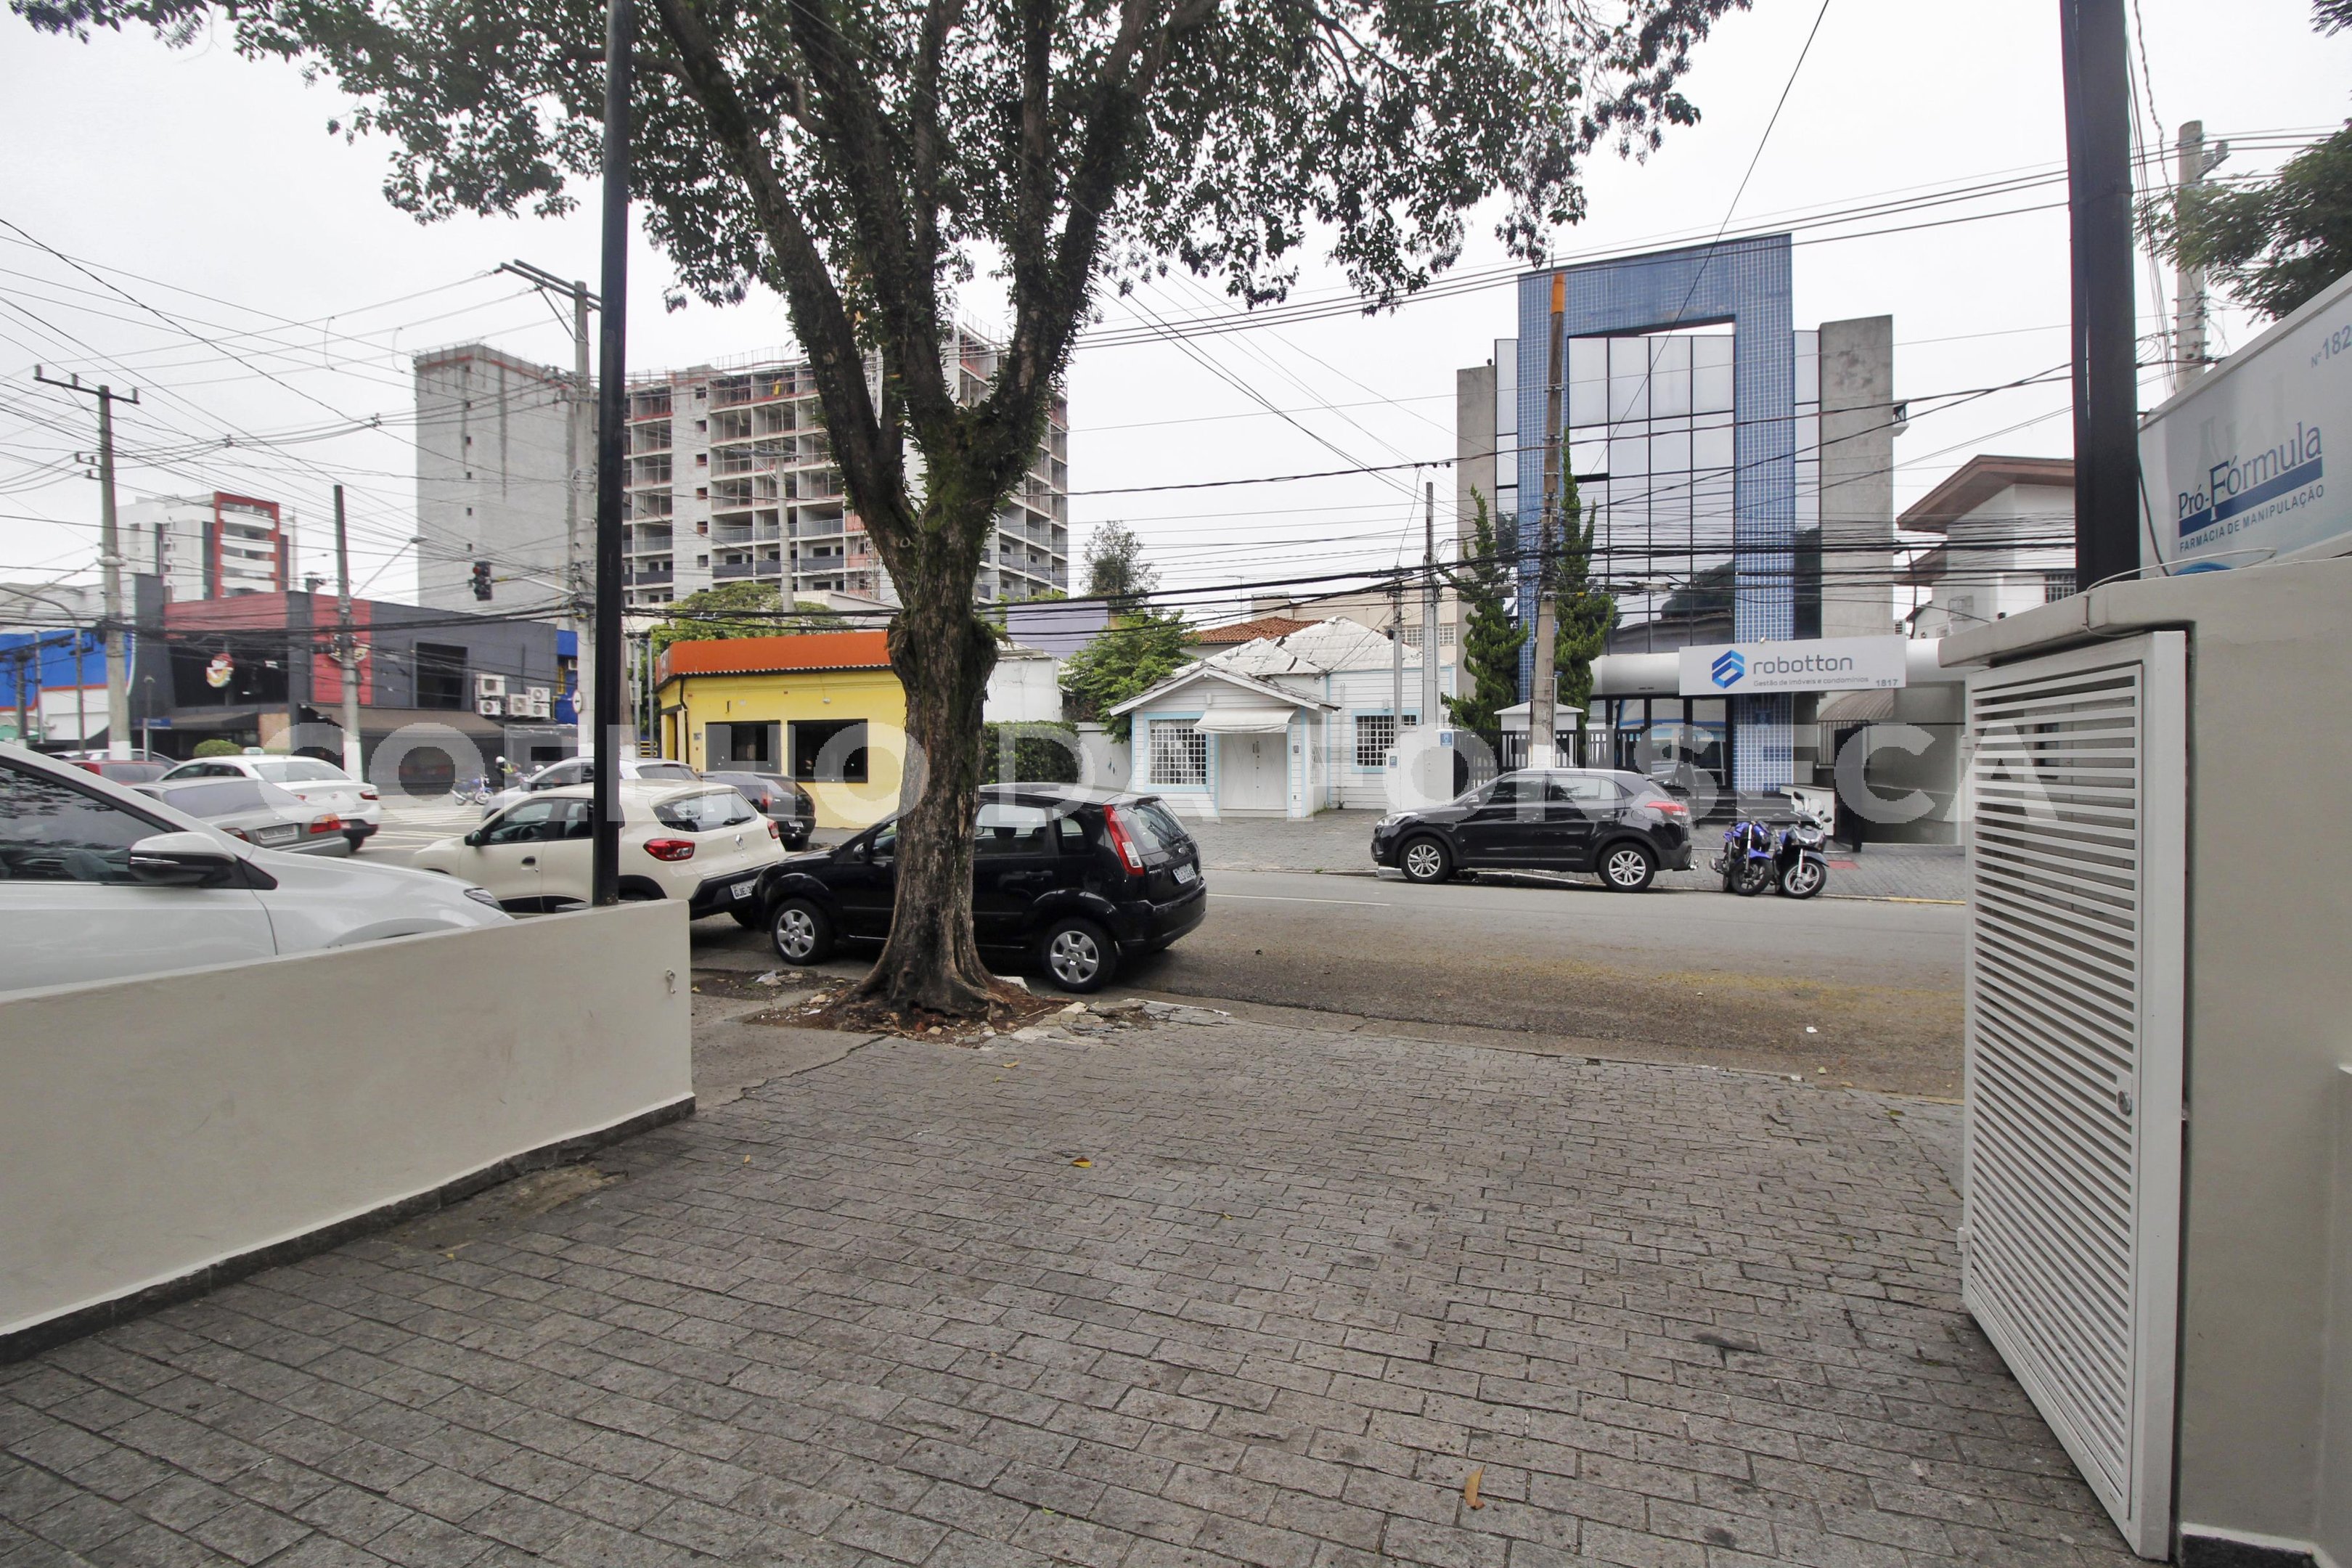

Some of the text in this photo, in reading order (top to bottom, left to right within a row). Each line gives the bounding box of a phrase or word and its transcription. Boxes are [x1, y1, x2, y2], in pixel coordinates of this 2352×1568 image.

[2179, 421, 2322, 520] Pró-Fórmula
[2180, 484, 2324, 552] FARMÁCIA DE MANIPULAÇÃO
[1753, 655, 1853, 674] robotton
[1823, 676, 1869, 685] condomínios
